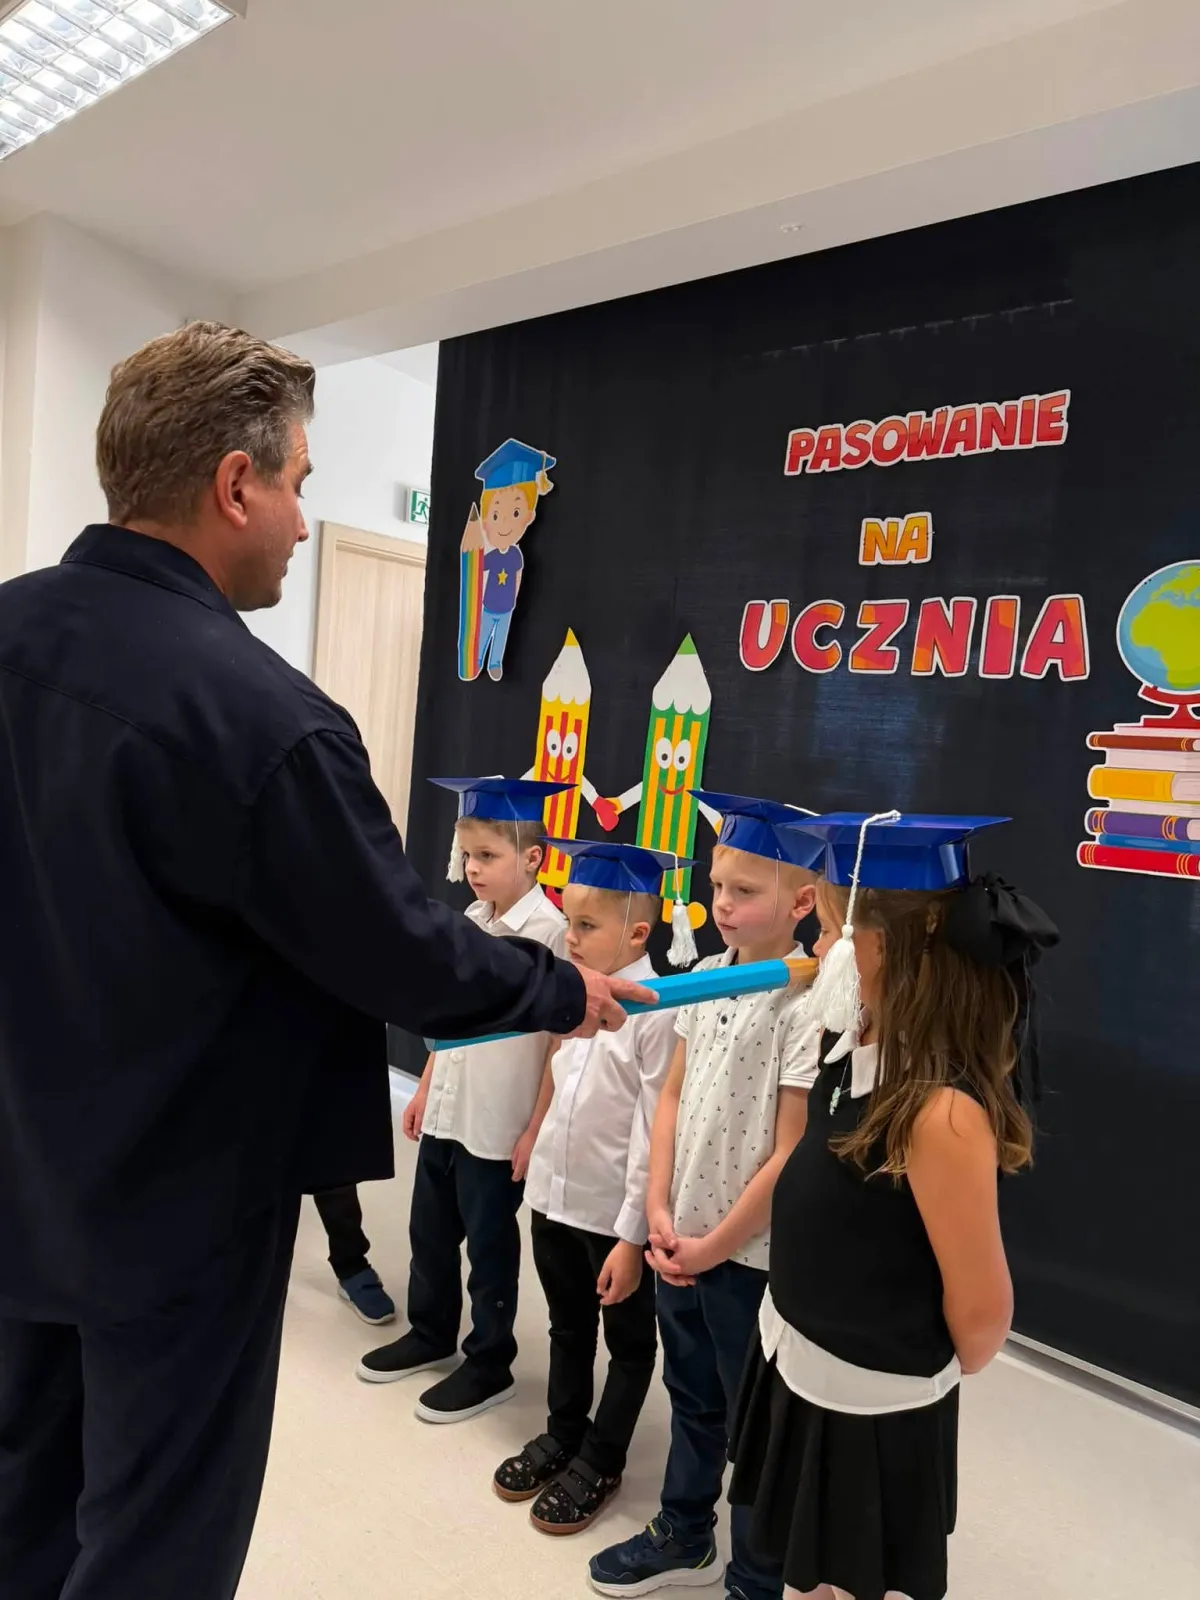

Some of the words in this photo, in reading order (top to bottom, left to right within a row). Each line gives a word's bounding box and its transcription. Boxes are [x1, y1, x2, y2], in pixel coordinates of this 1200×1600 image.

[785, 390, 1070, 475] PASOWANIE
[860, 513, 931, 564] NA
[740, 595, 1089, 680] UCZNIA
